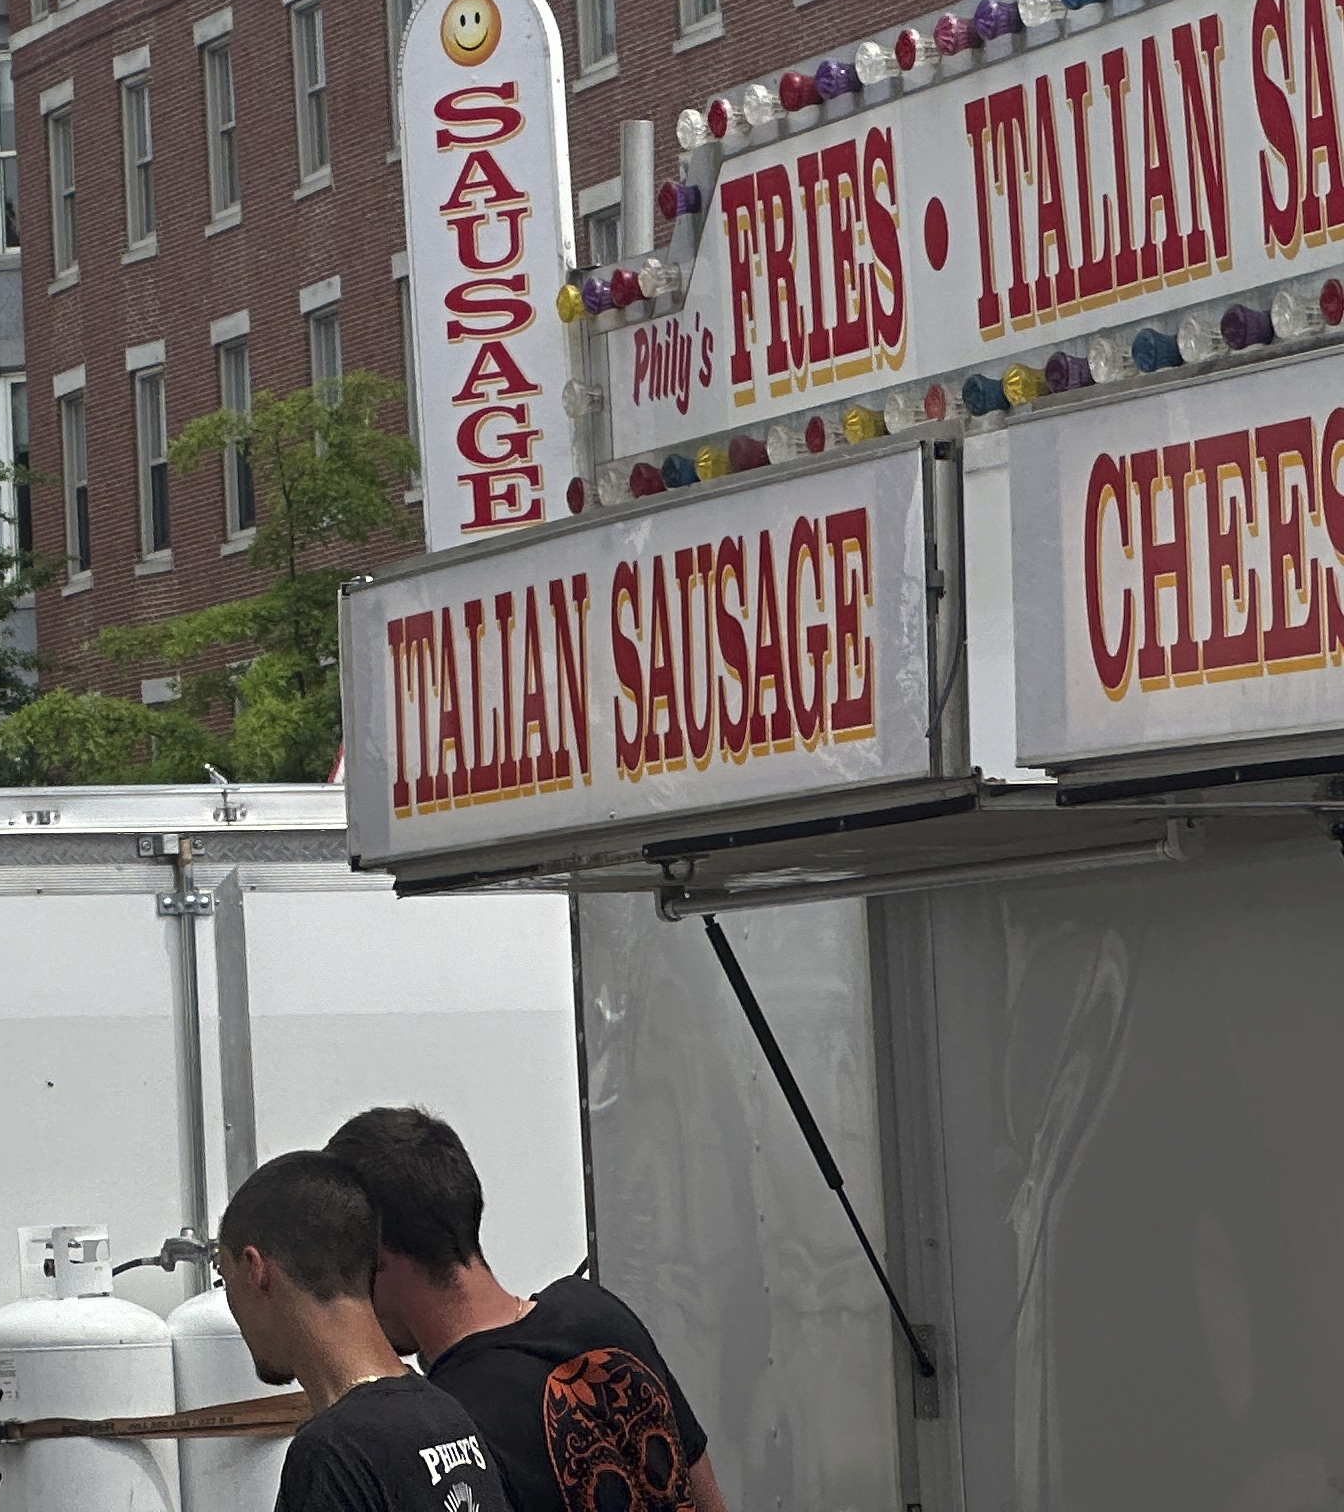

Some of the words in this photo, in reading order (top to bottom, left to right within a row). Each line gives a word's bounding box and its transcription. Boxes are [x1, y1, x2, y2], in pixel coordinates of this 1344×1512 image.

[433, 81, 548, 534] SAUSAGE
[633, 312, 714, 416] Phily's
[720, 126, 909, 407] FRIES
[965, 13, 1233, 343] ITALIAN
[387, 572, 593, 820] ITALIAN
[611, 506, 877, 784] SAUSAGE
[418, 1435, 487, 1486] PHILY'S
